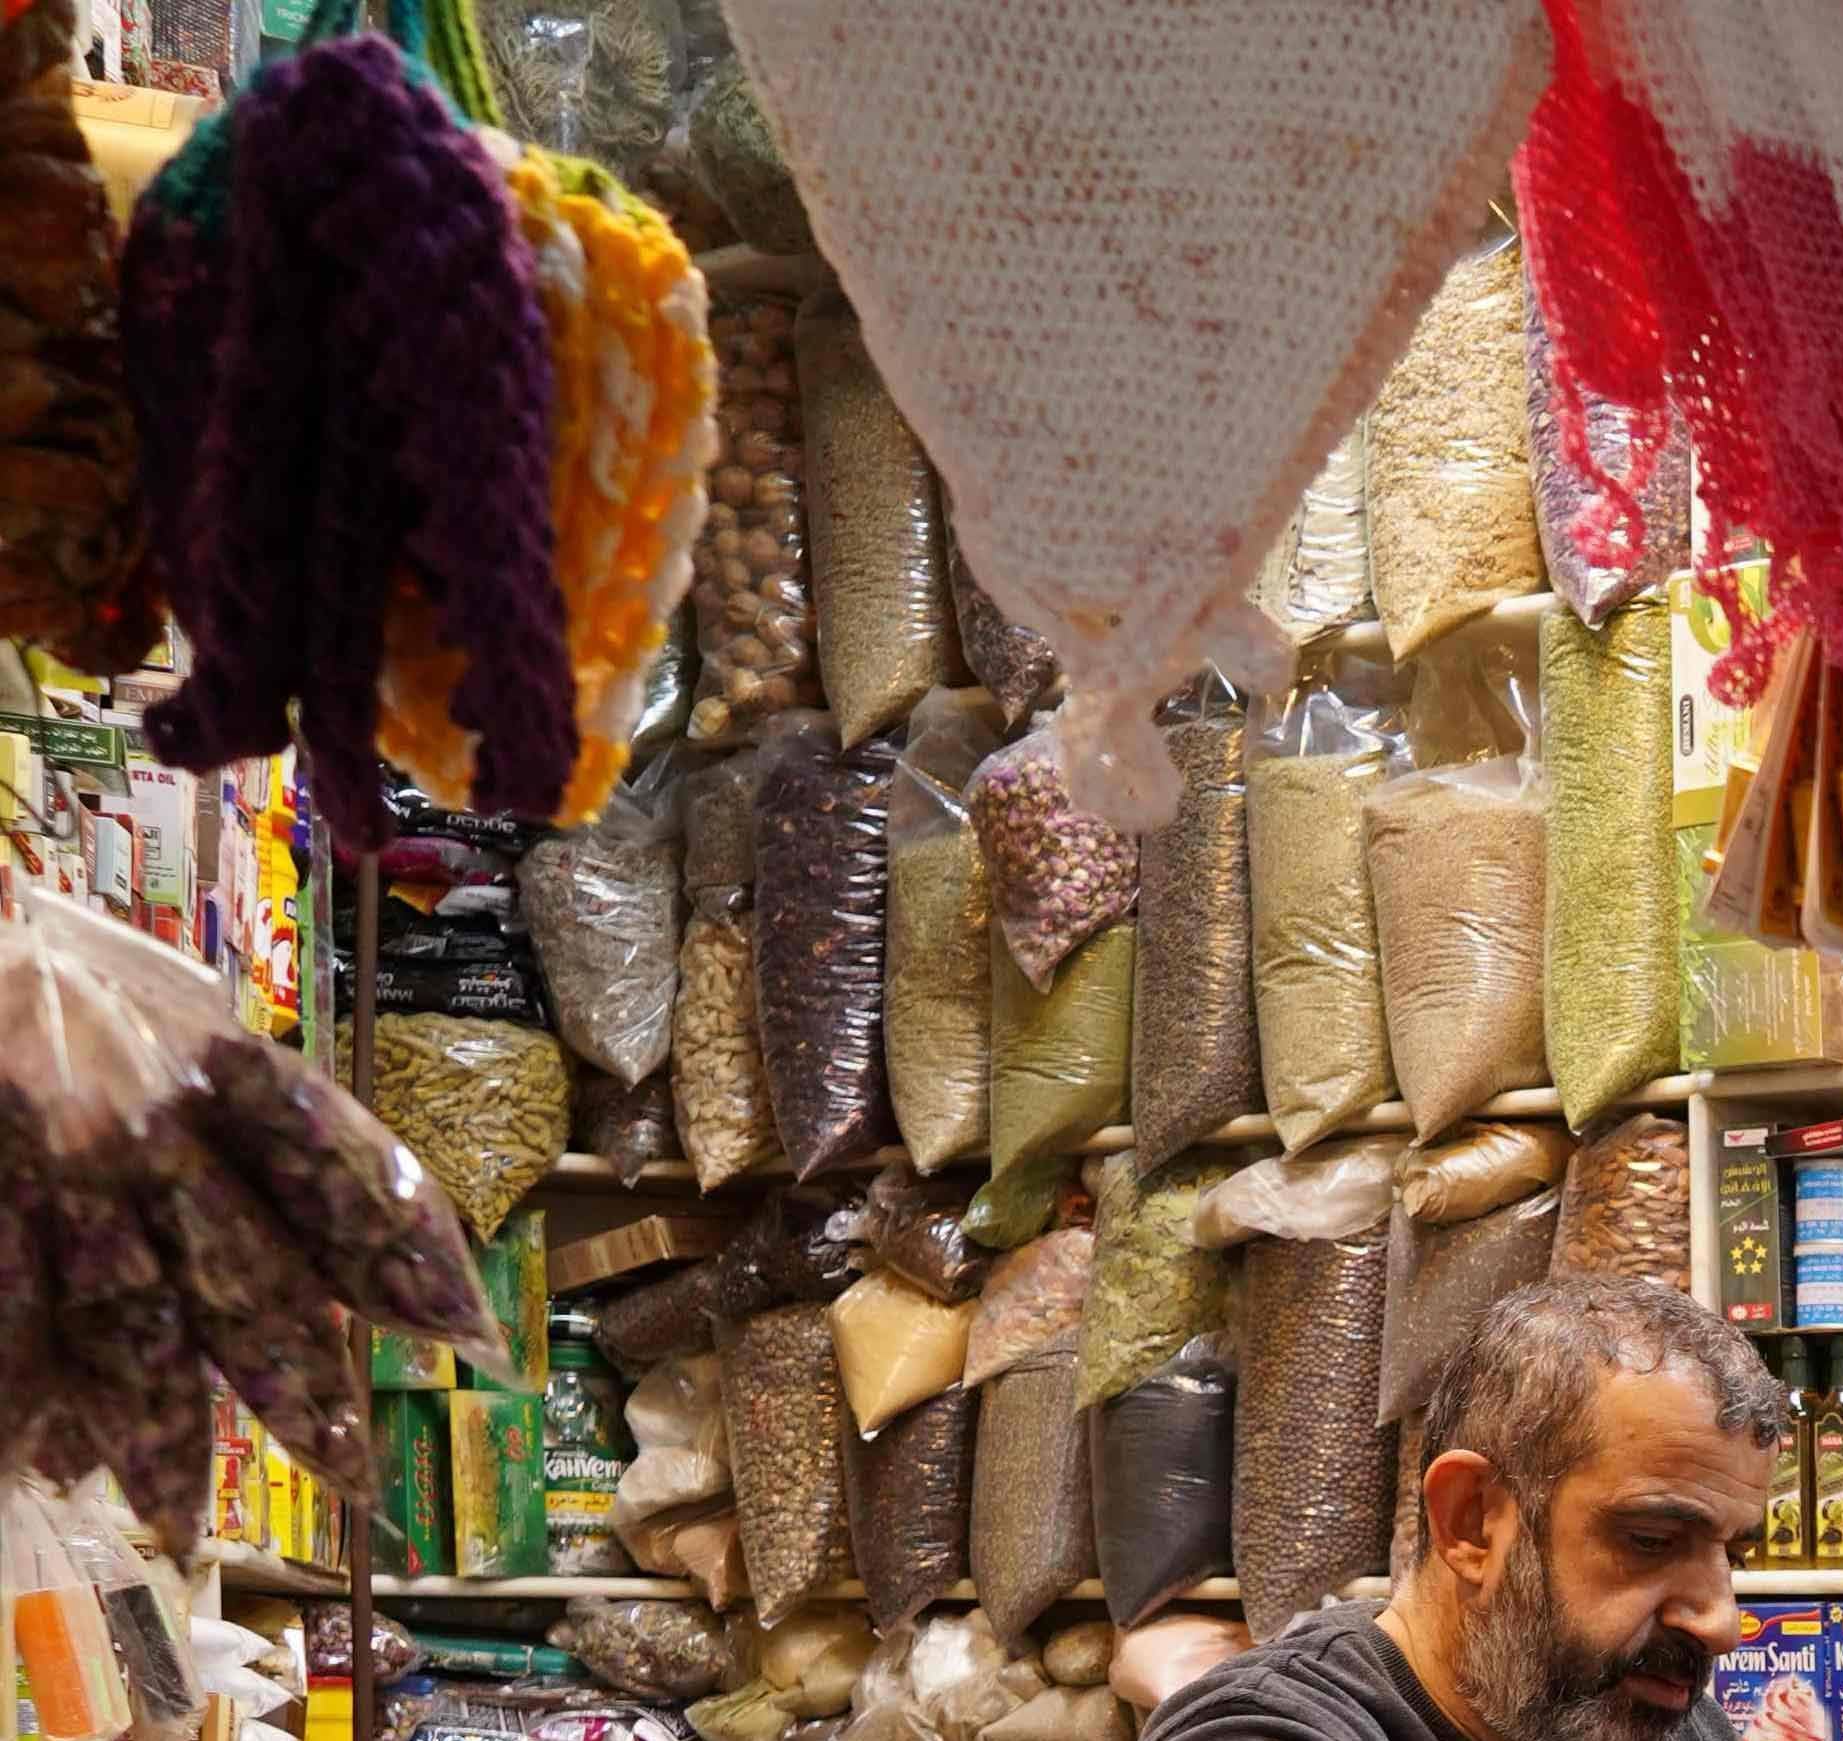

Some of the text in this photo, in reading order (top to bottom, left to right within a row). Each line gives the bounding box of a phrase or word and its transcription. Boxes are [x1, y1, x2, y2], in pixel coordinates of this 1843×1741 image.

[158, 771, 176, 786] OIL
[544, 1454, 623, 1481] kahvem
[1719, 1642, 1816, 1676] Krem Şanti
